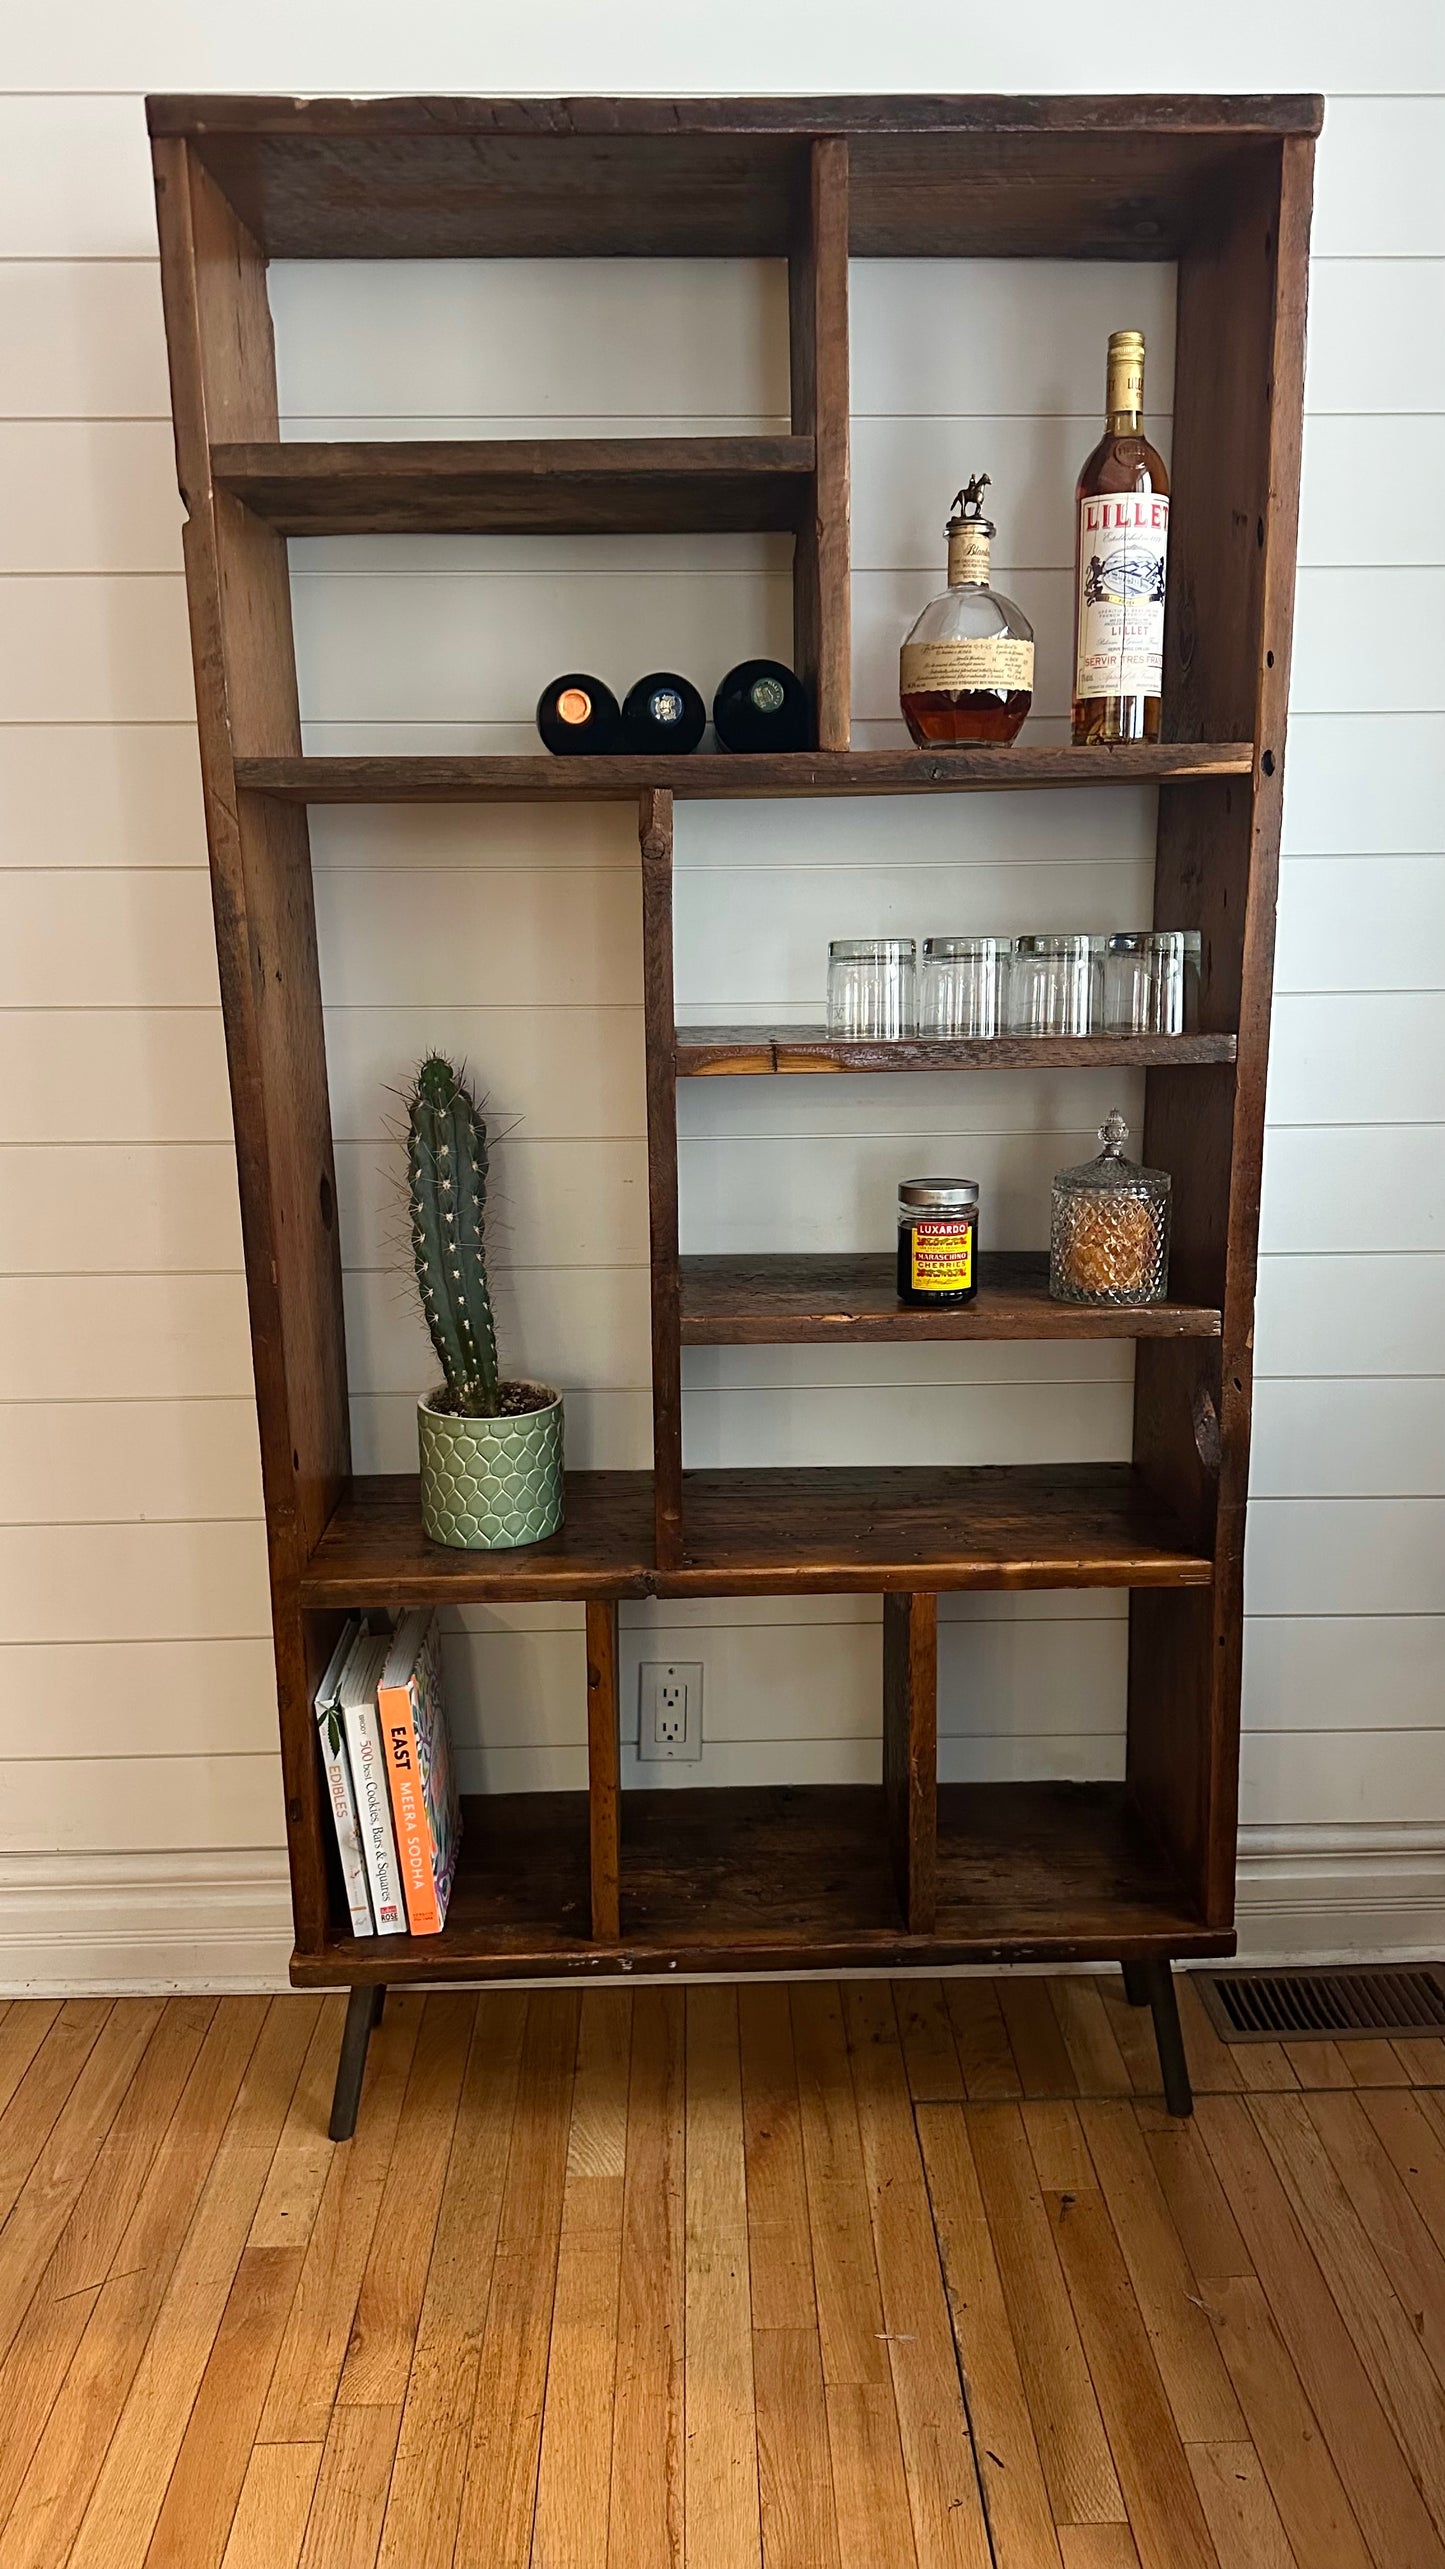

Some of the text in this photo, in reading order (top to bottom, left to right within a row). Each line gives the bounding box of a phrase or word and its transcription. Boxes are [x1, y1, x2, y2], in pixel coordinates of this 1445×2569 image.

[1111, 626, 1149, 636] LILLET
[1085, 655, 1117, 667] SERVIR
[919, 1224, 966, 1234] LUXARDO
[918, 1252, 966, 1260] MARASCHINO
[918, 1261, 966, 1269] CHERRIES
[359, 1740, 374, 1763] 500
[391, 1726, 411, 1770] EAST
[362, 1763, 372, 1780] best
[328, 1765, 349, 1819] EDIBLES
[365, 1781, 380, 1826] Cookies,
[372, 1826, 384, 1849] Bars
[400, 1782, 425, 1889] MEERA SODHA
[375, 1850, 385, 1861] &
[376, 1863, 390, 1902] Squares
[381, 1912, 398, 1921] ROSE
